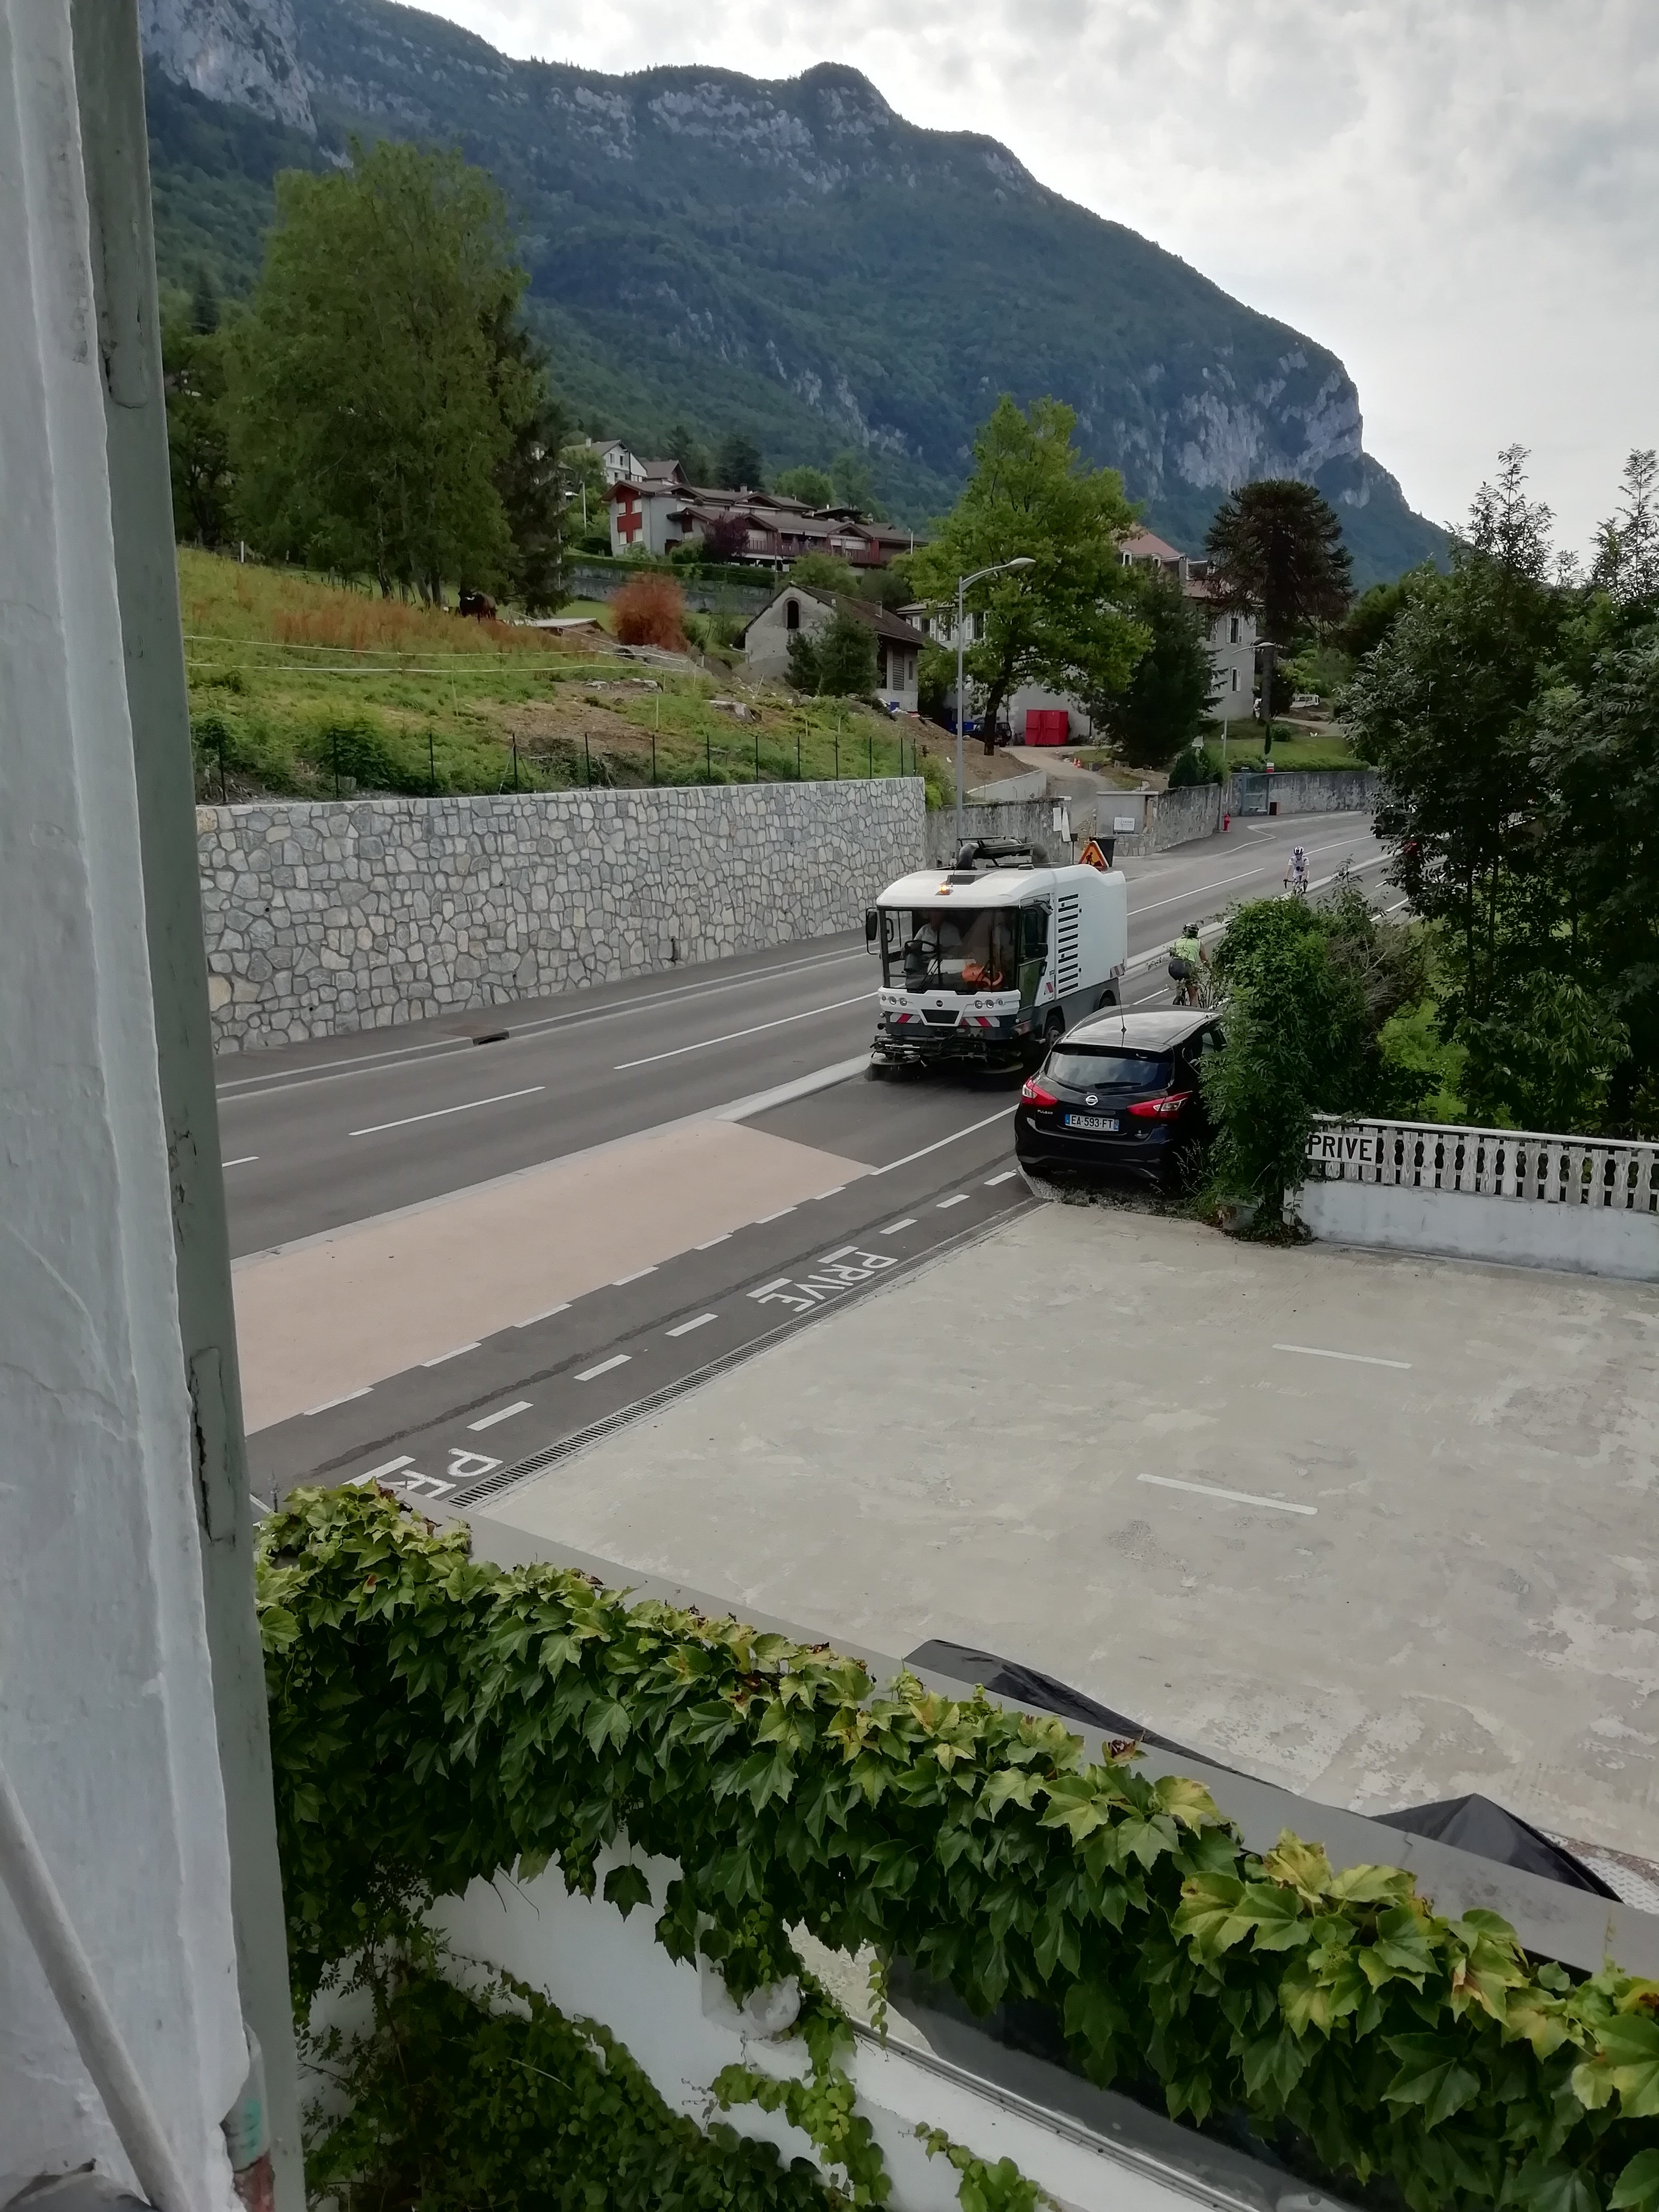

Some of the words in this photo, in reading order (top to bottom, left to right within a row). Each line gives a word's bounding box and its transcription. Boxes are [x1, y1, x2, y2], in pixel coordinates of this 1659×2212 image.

[1071, 1116, 1113, 1128] EA-593-FT
[1308, 1134, 1372, 1161] PRIVE
[757, 1251, 899, 1312] PRIVE
[385, 1447, 504, 1498] PR
